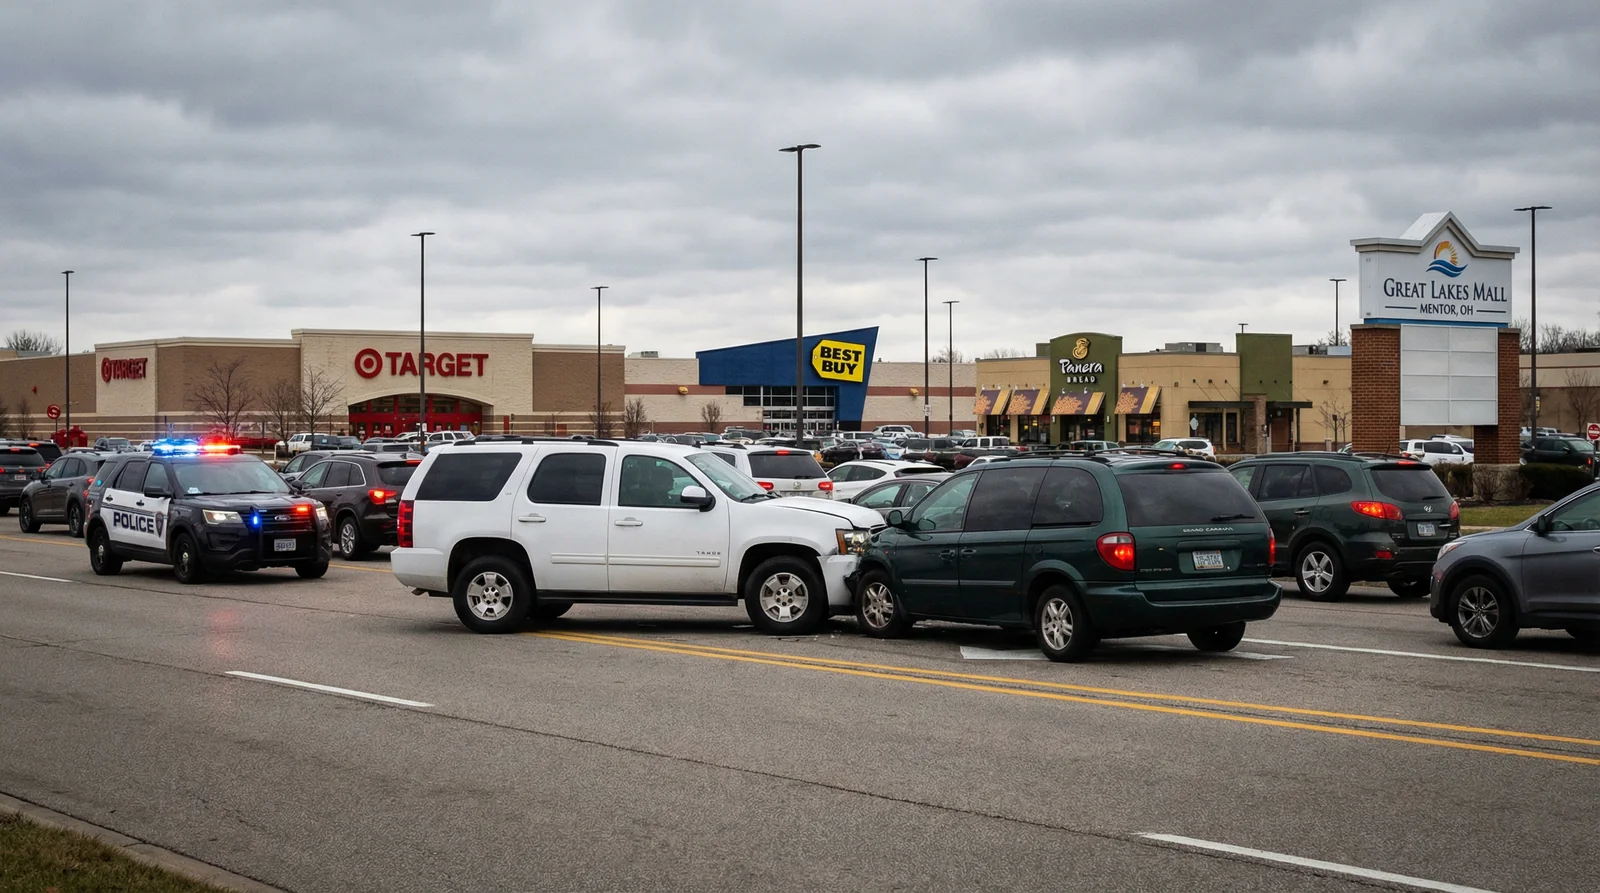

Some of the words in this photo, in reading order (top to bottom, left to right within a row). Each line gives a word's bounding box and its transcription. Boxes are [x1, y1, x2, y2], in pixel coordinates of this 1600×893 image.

[1384, 278, 1426, 298] GREAT
[1431, 281, 1469, 300] LAKES
[1473, 282, 1507, 302] MALL
[1420, 303, 1459, 316] MENTOR,
[1460, 305, 1474, 315] OH
[820, 346, 862, 362] BEST
[110, 358, 148, 379] TARGET
[385, 352, 489, 377] TARGET
[822, 360, 858, 375] BUY
[1059, 359, 1103, 374] Panera
[113, 511, 155, 534] POLICE
